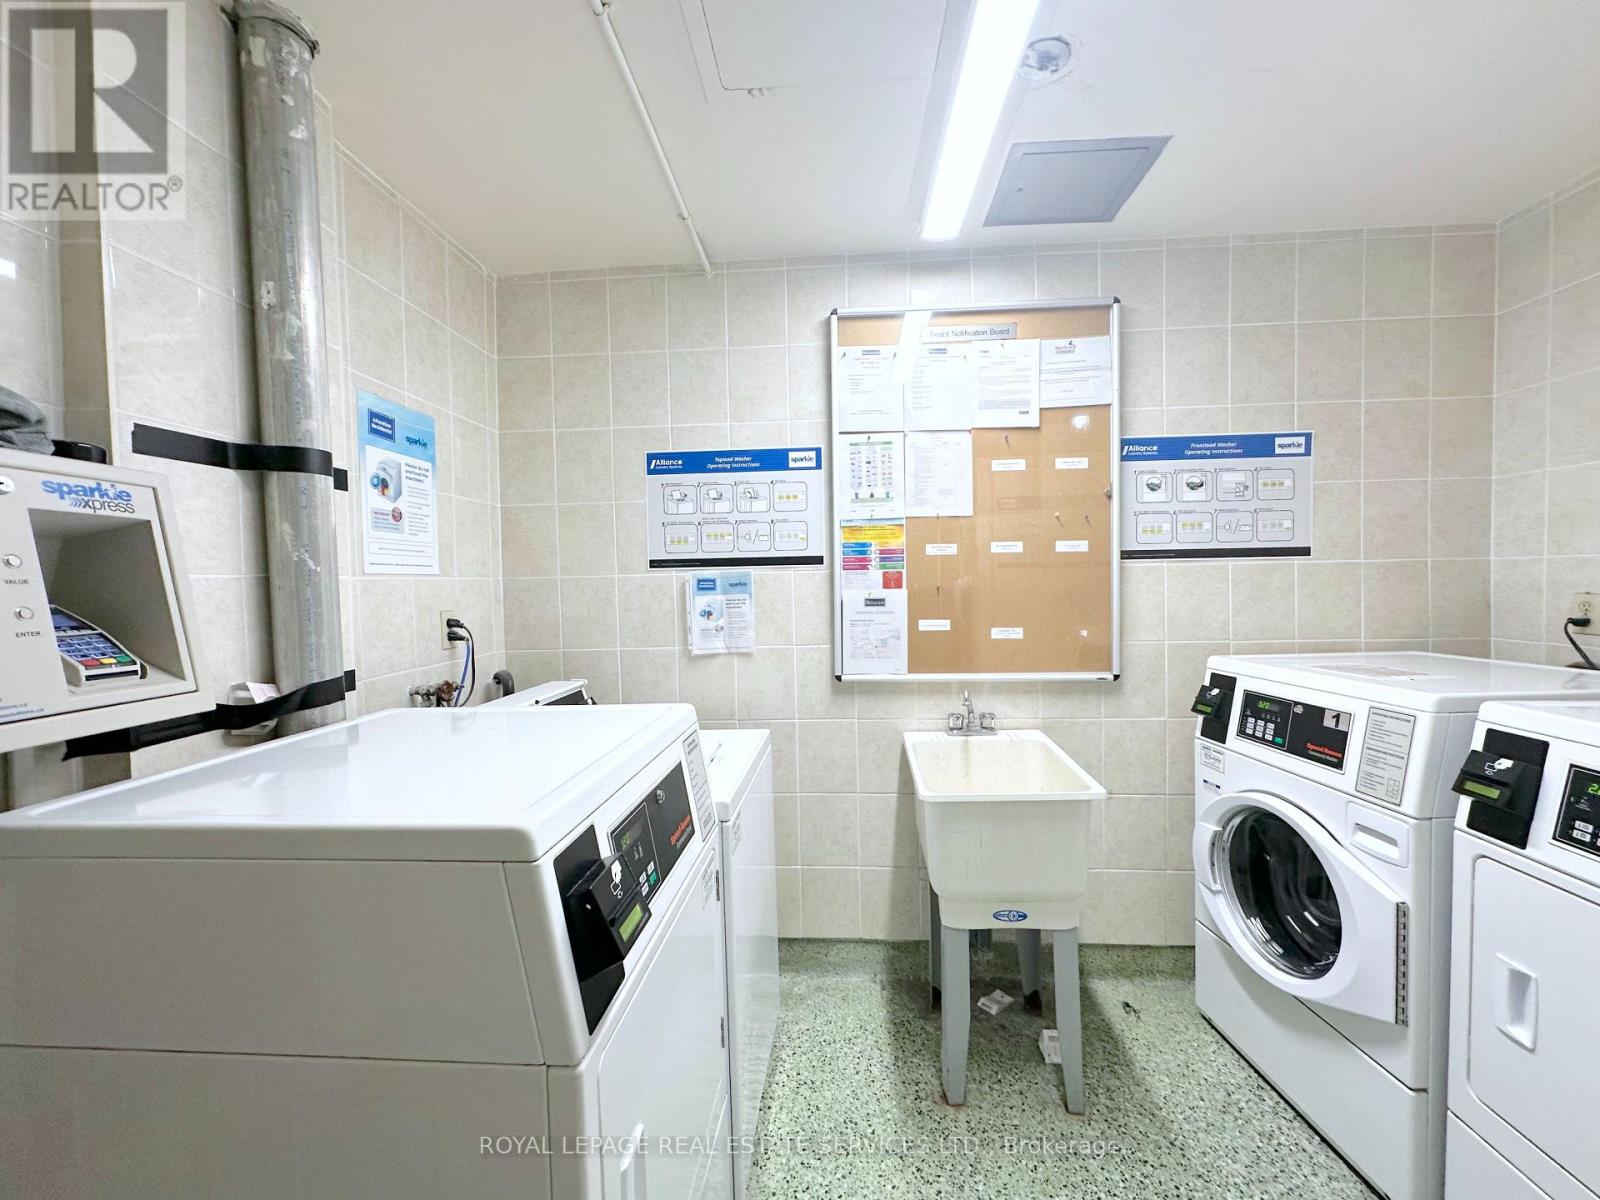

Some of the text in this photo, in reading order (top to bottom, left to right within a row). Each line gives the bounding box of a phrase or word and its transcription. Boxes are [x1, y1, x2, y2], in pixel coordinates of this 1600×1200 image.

[951, 329, 988, 337] Notification
[989, 328, 1010, 336] Board
[82, 498, 135, 514] xpress
[1331, 712, 1342, 729] 1
